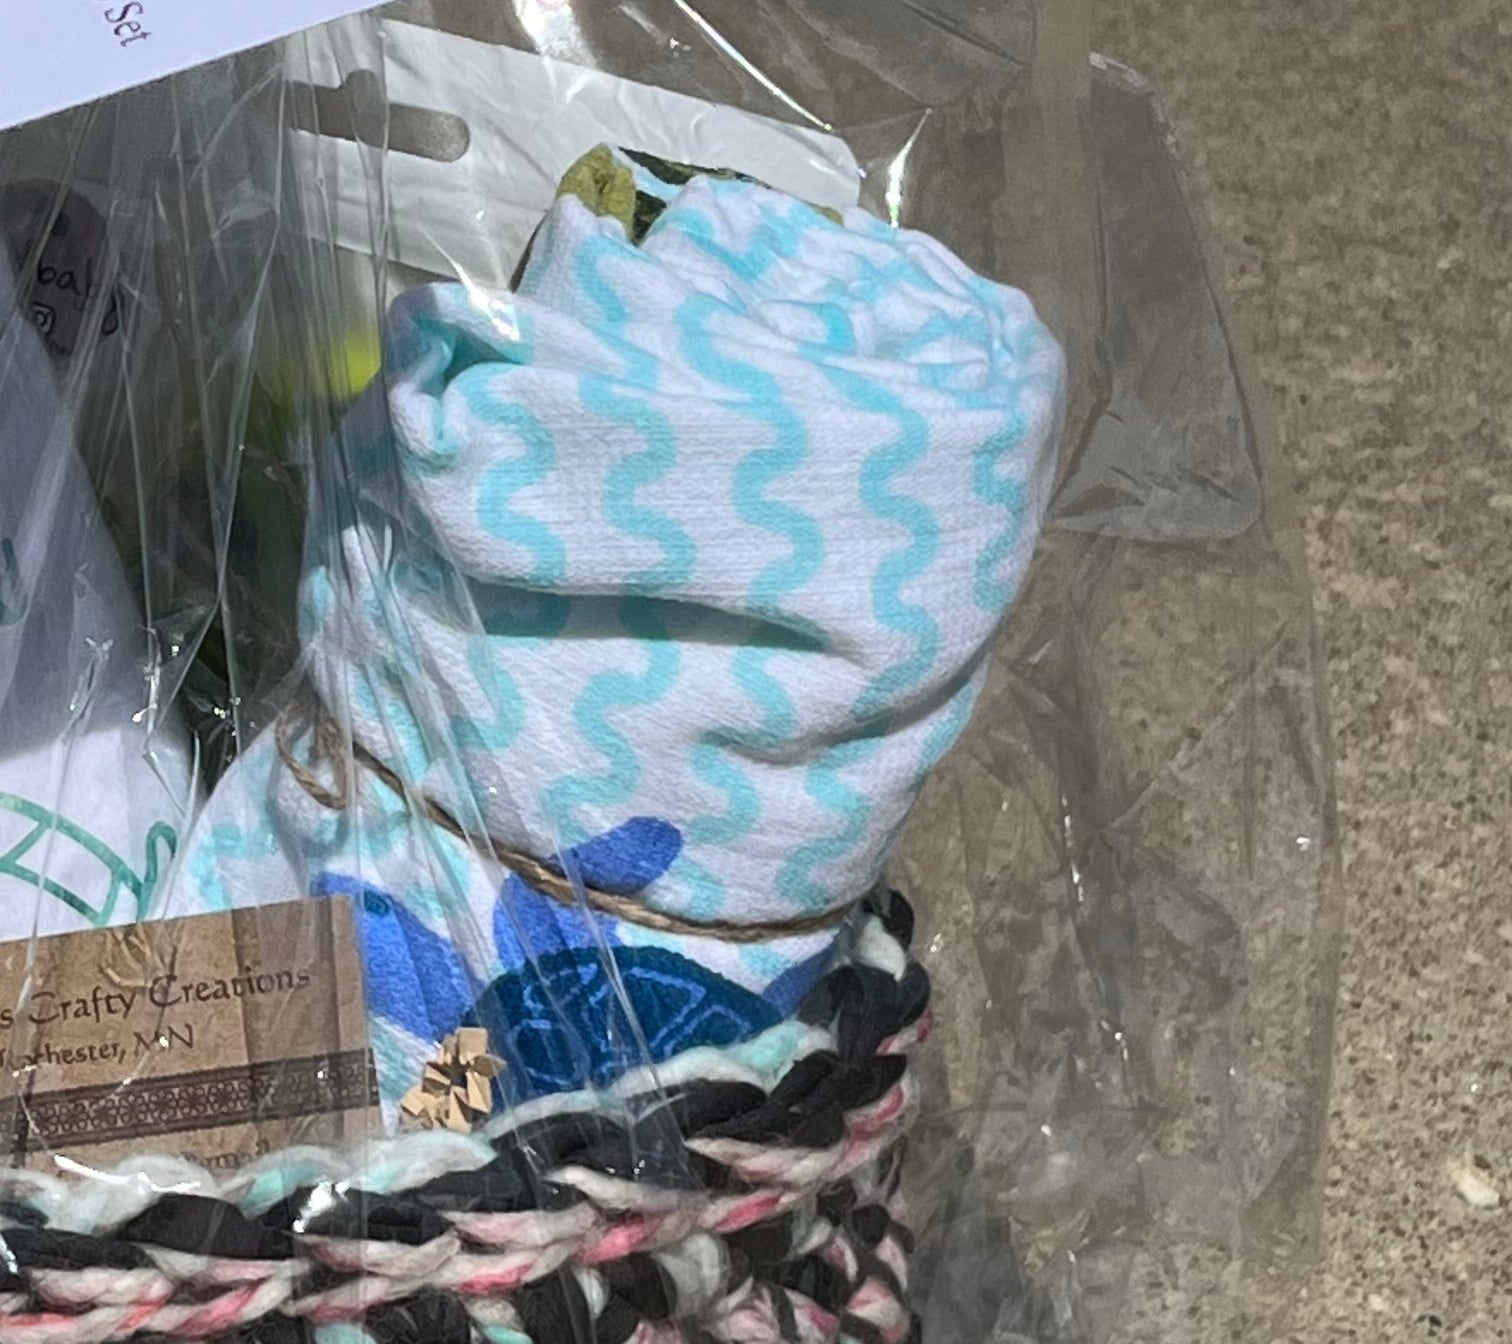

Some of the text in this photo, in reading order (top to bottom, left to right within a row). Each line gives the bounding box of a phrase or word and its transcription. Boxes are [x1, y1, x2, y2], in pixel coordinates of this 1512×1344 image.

[102, 0, 152, 48] Set
[29, 988, 136, 1025] Crafty
[148, 966, 311, 1008] Creations
[133, 1023, 196, 1056] MN
